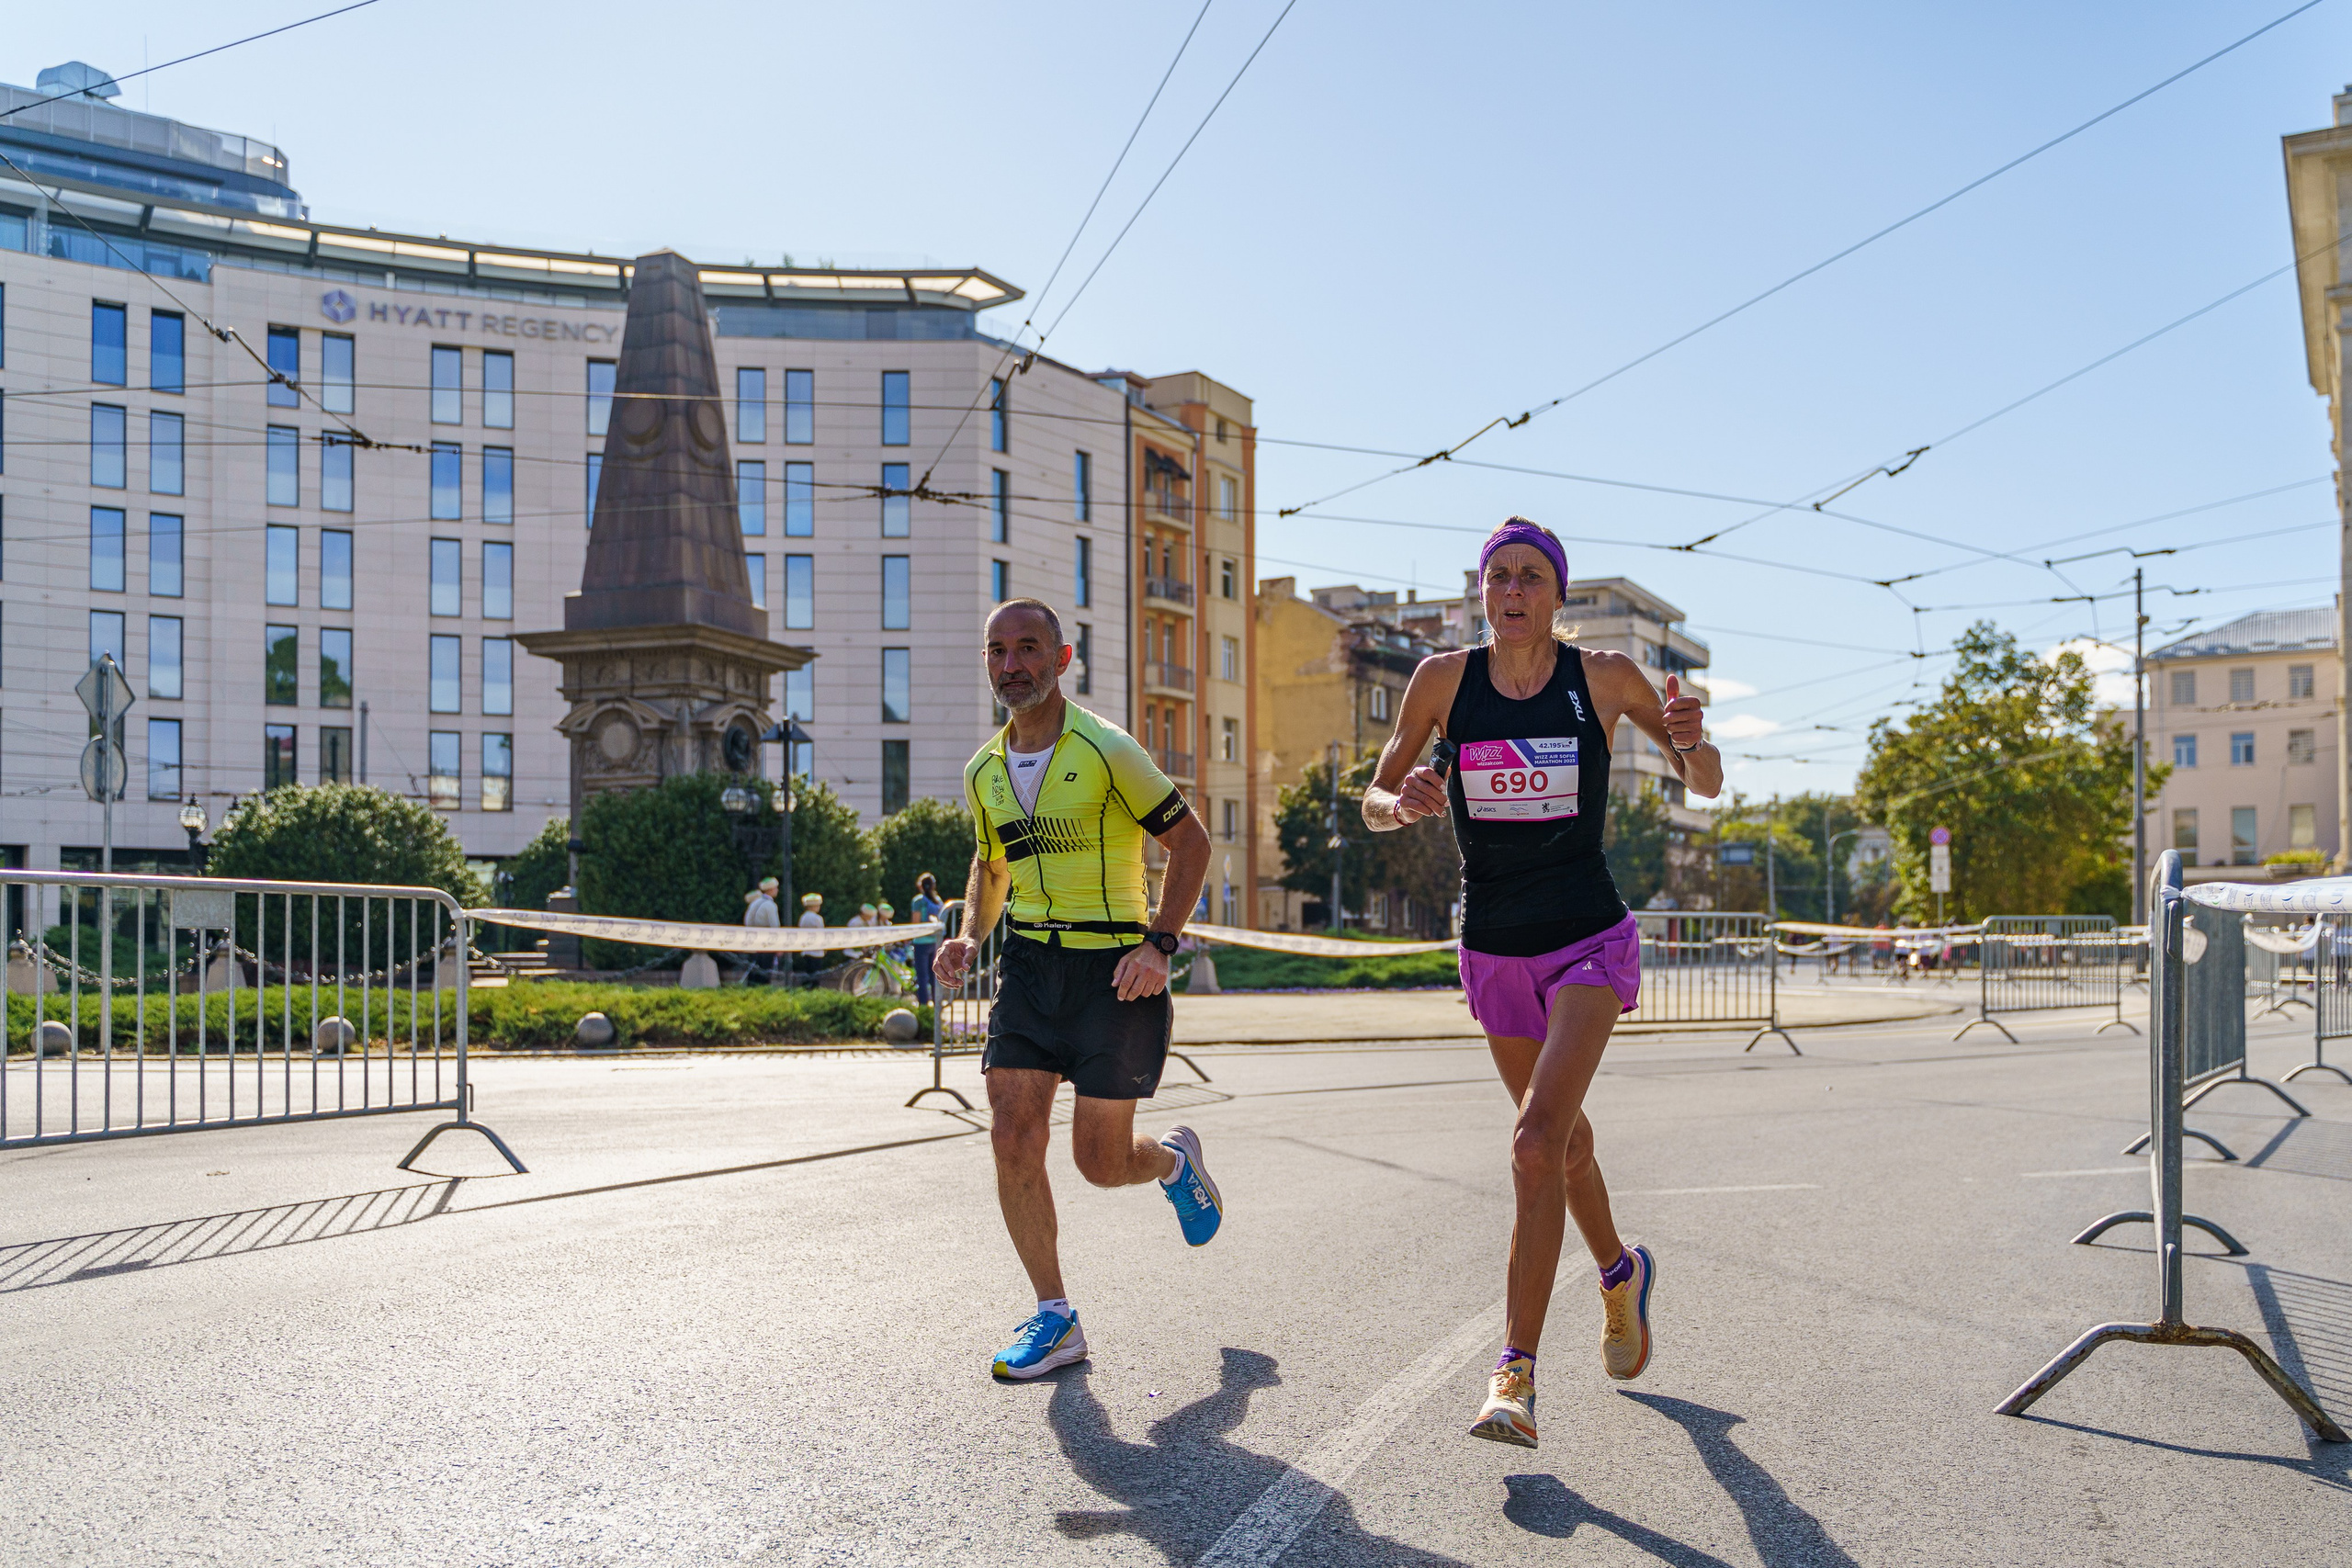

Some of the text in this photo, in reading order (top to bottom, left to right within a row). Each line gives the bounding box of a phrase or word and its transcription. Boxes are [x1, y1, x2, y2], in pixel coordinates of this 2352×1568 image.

[369, 301, 618, 344] HYATT REGENCY
[1567, 691, 1586, 722] 2XU
[1490, 770, 1549, 795] 690
[1044, 922, 1072, 931] Kalenji
[1188, 1173, 1212, 1210] HOKA
